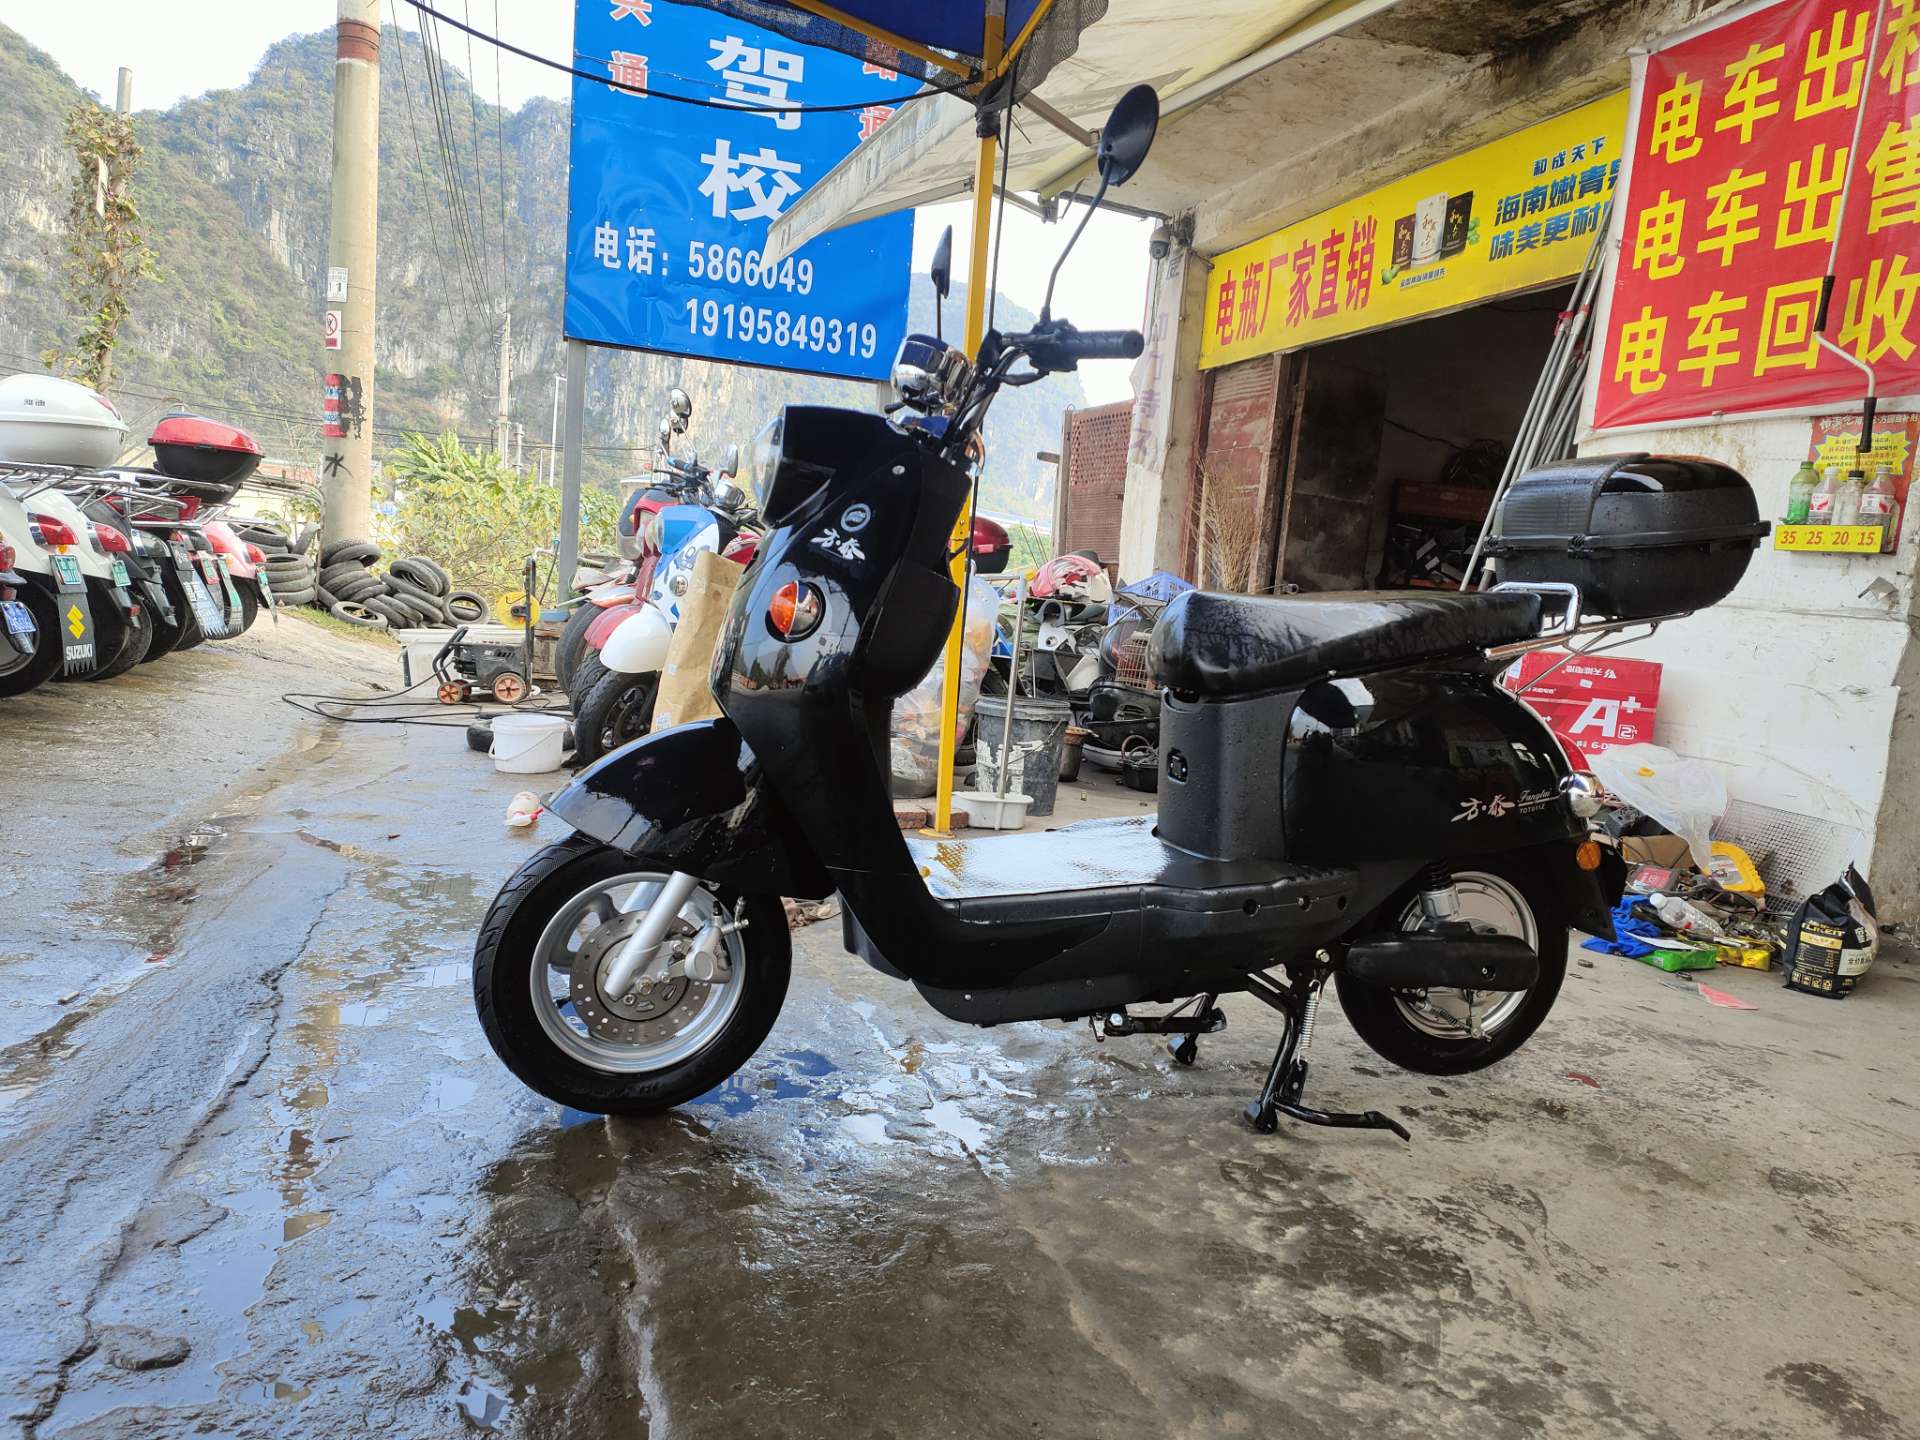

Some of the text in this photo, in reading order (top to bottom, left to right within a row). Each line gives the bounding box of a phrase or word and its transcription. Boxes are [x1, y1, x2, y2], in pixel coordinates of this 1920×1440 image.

[698, 35, 805, 222] 驾校
[1533, 137, 1605, 176] 和成天下
[1489, 200, 1610, 262] 味美更耐
[1632, 120, 1920, 281] 电车出售
[1215, 214, 1378, 346] 电瓶厂家直销
[686, 298, 878, 360] 19195849319
[1614, 254, 1920, 395] 电车回收
[1780, 530, 1875, 546] 35 25 20 15
[65, 643, 93, 660] SUZUKI
